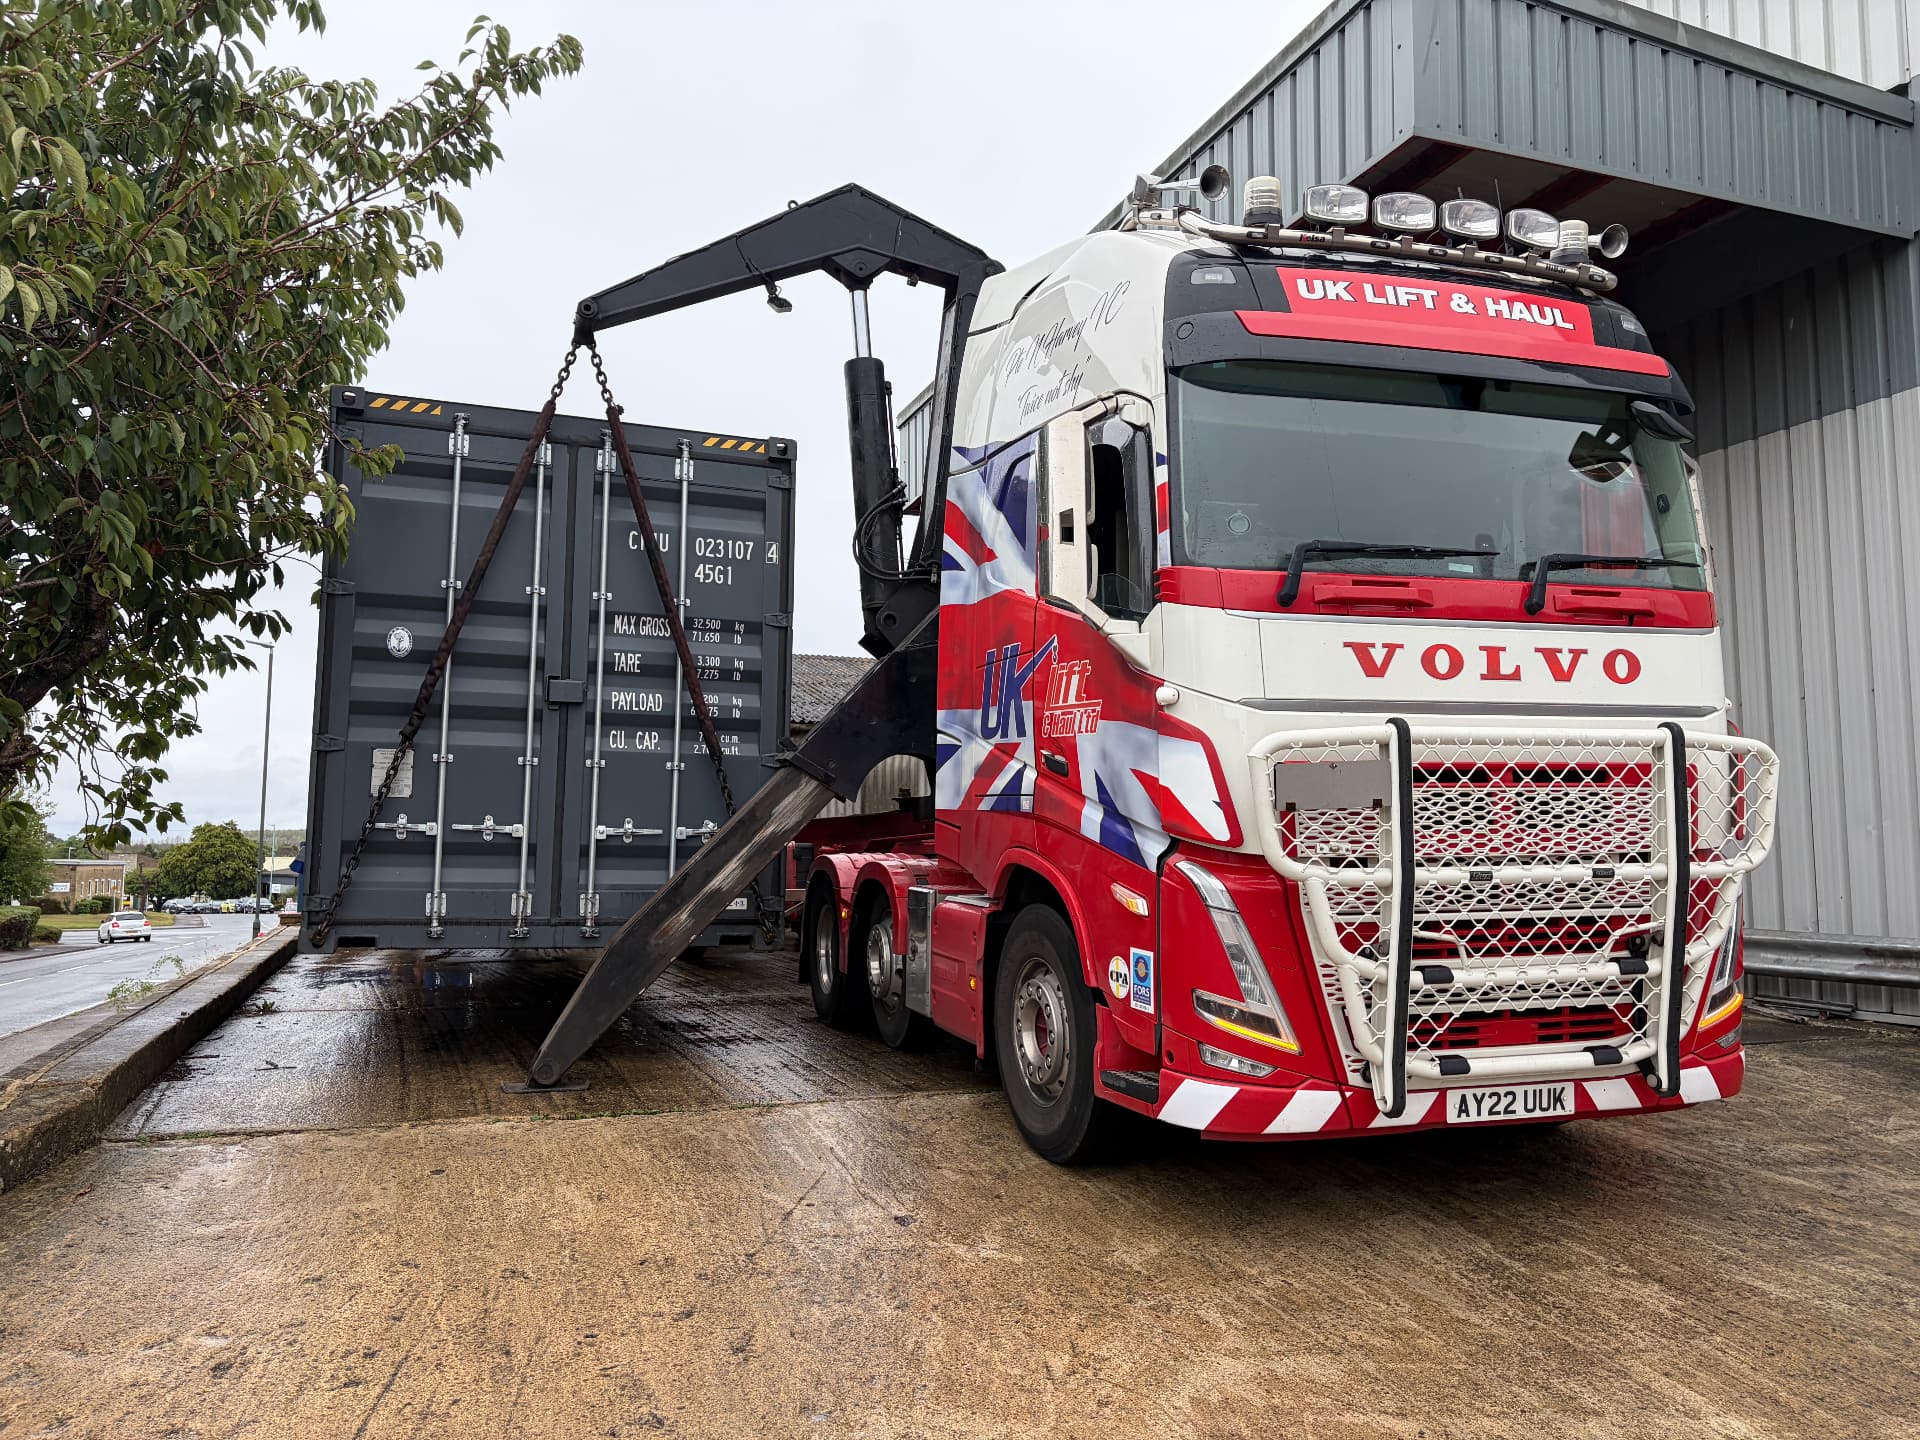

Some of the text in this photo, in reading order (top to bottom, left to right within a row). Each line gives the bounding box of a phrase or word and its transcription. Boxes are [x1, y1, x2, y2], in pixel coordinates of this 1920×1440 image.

[1296, 277, 1575, 330] UK LIFT & HAUL
[629, 530, 778, 563] CU 023107 4
[694, 564, 732, 585] 45G1
[614, 615, 745, 637] MAX GROSS 32.500 kg
[692, 631, 742, 644] 71.650 lb
[614, 652, 744, 673] TARE 3.300 kg
[1343, 641, 1642, 684] VOLVO
[696, 669, 741, 681] 7.275 lb
[980, 634, 1058, 740] UK
[611, 691, 663, 712] PAYLOAD
[732, 695, 742, 708] kg
[732, 707, 741, 718] lb
[1050, 711, 1077, 737] Haul
[1076, 709, 1101, 735] Ltd
[609, 730, 628, 749] CU.
[636, 731, 661, 750] CAP.
[1110, 970, 1128, 985] CPA
[1133, 984, 1150, 997] FORS
[1456, 1086, 1566, 1118] AY22 UUK
